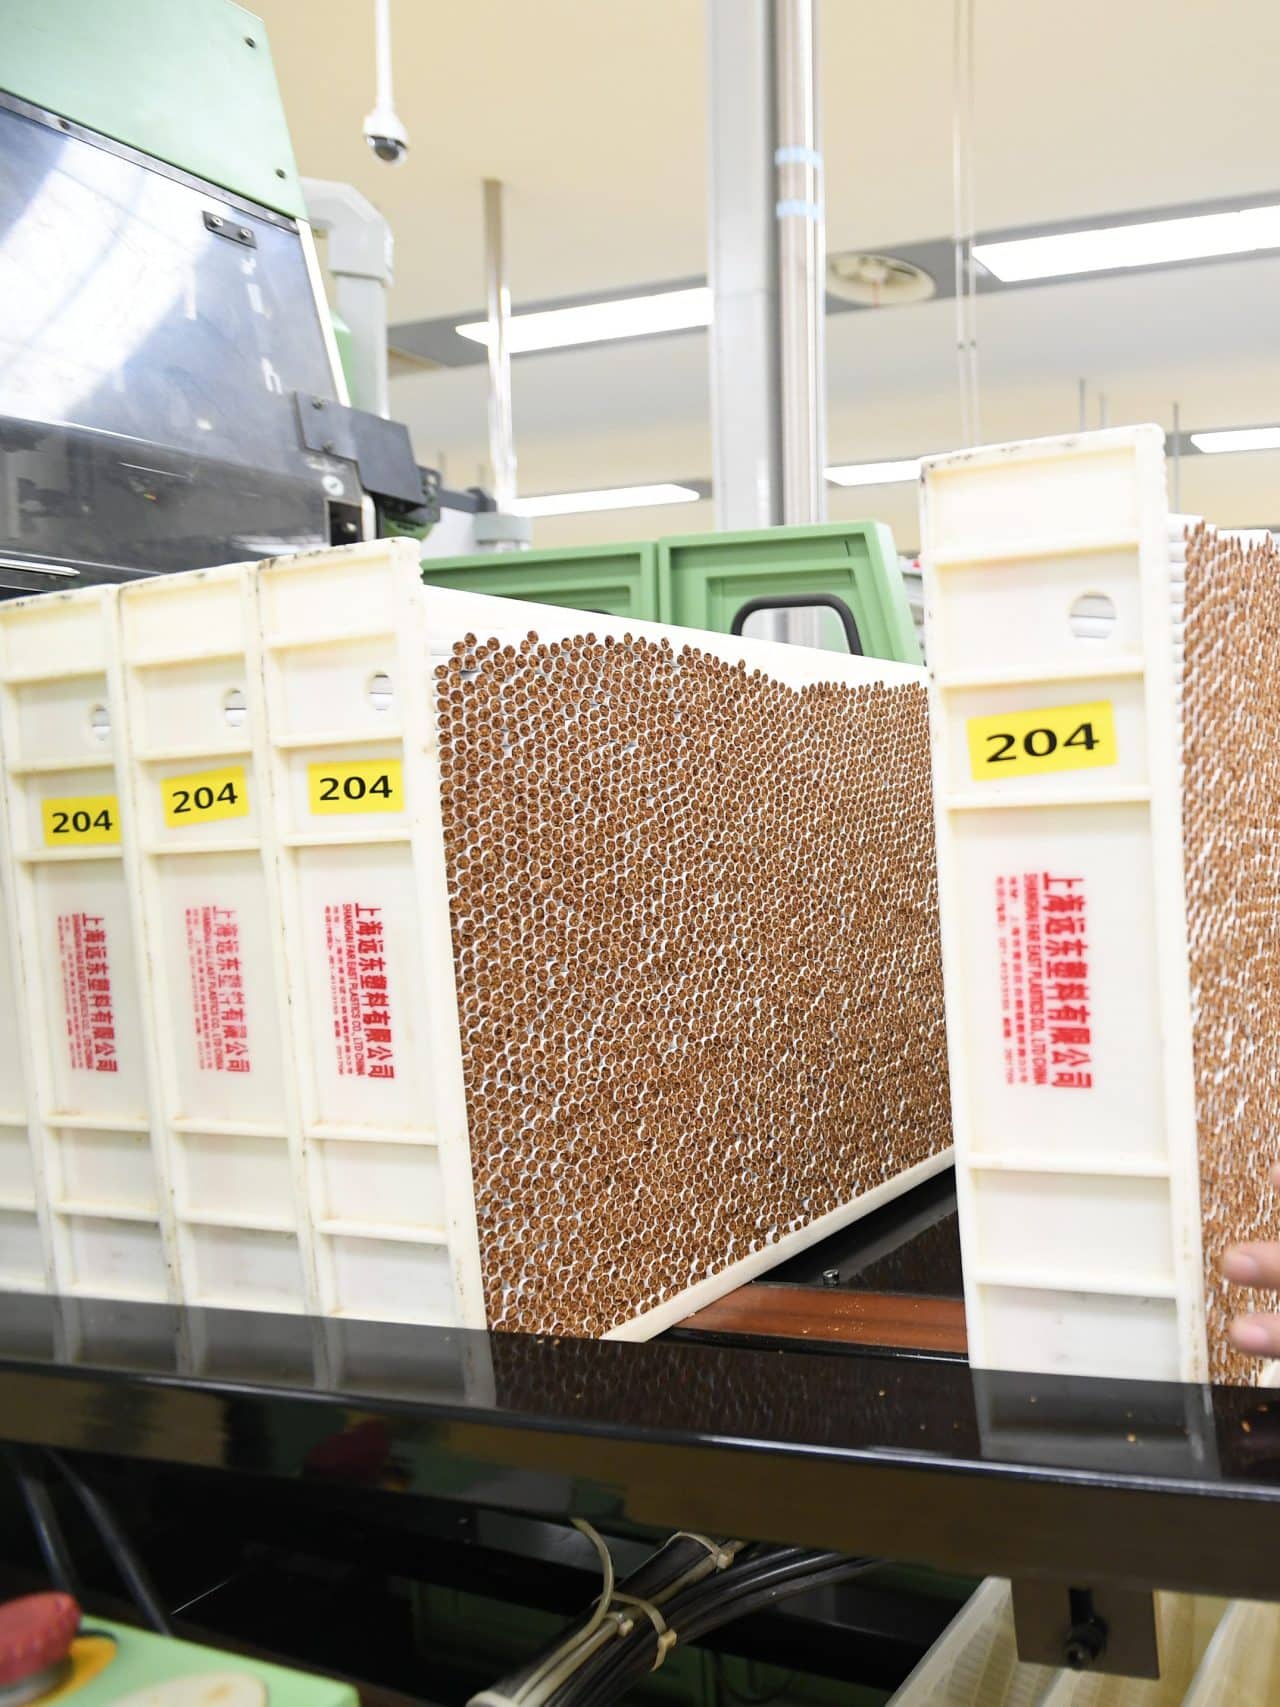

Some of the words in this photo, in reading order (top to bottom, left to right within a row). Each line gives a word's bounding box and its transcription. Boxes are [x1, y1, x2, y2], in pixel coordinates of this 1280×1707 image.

[985, 721, 1101, 763] 204
[172, 782, 239, 814] 204
[318, 774, 393, 801] 204
[51, 809, 114, 834] 204
[343, 904, 353, 943] SHANGHAI
[347, 961, 357, 980] EAST
[1028, 945, 1041, 968] EAST
[82, 913, 118, 1072] 上海远东塑料有限公司
[355, 903, 394, 1079] 上海远东塑料有限公司
[1030, 971, 1043, 1015] PLASTICS
[1042, 872, 1092, 1088] 上海远东塑料有限公司
[208, 982, 218, 1016] PLASTICS
[349, 983, 360, 1018] PLASTICS
